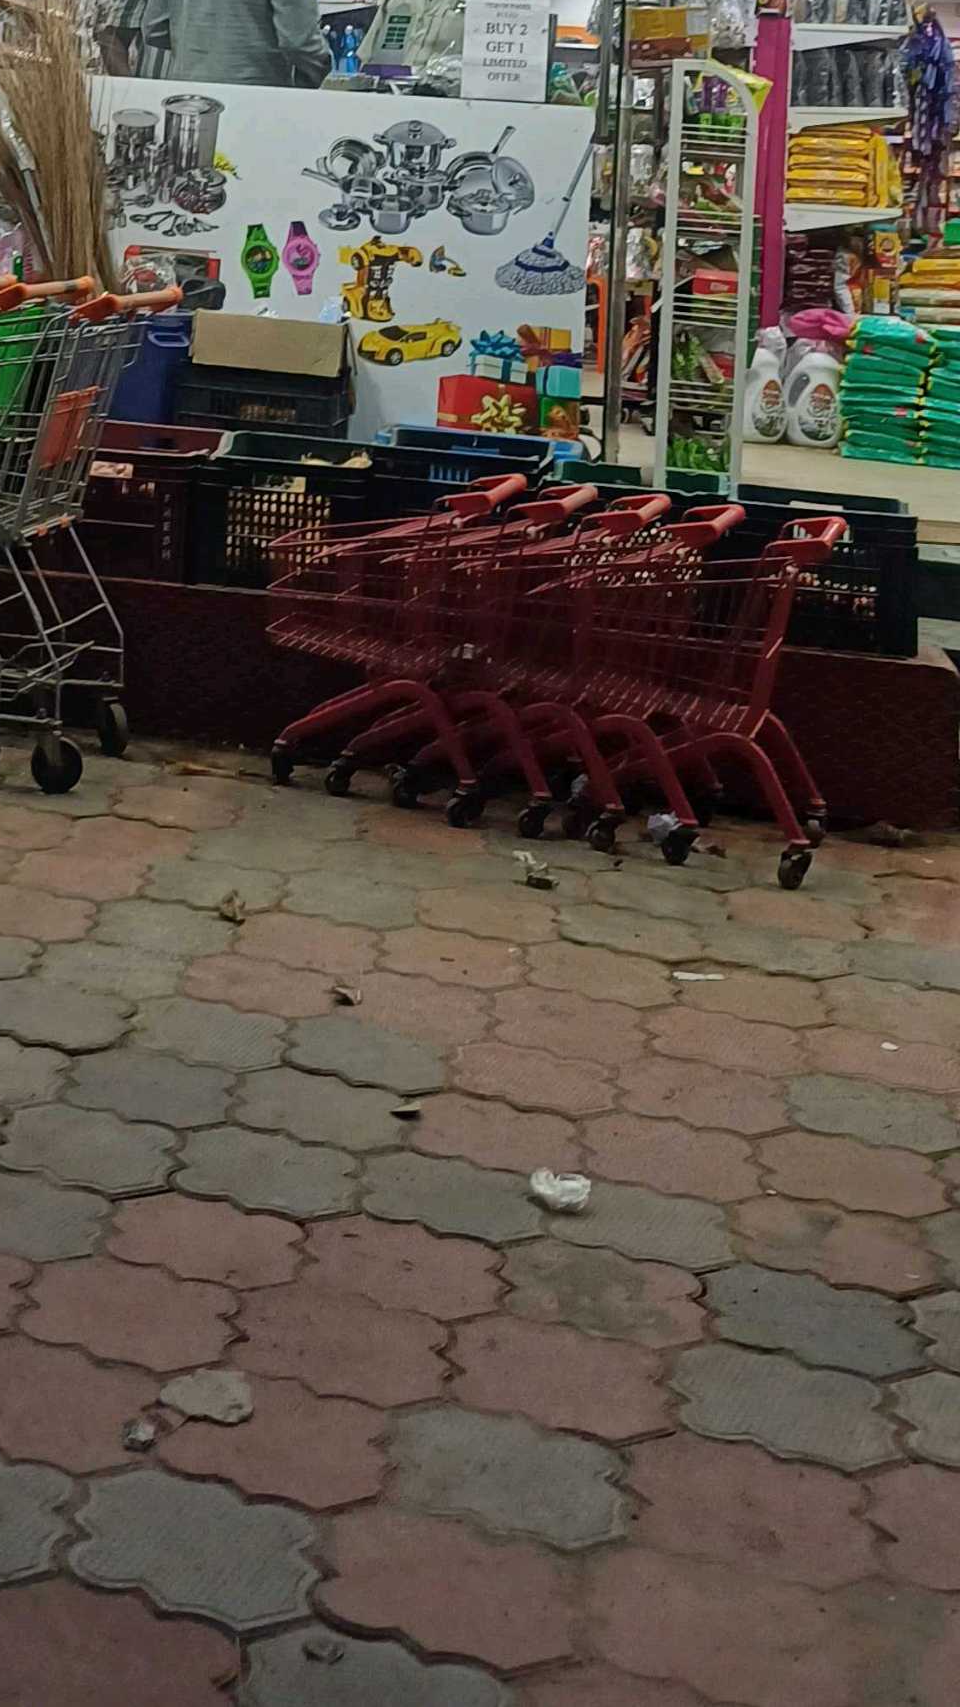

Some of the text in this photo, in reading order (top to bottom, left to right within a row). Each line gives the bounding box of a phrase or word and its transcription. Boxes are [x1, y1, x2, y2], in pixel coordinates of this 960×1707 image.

[486, 21, 529, 36] BUY 2
[486, 40, 525, 54] GET 1
[482, 58, 528, 69] LIMITED
[487, 71, 521, 82] OFFER
